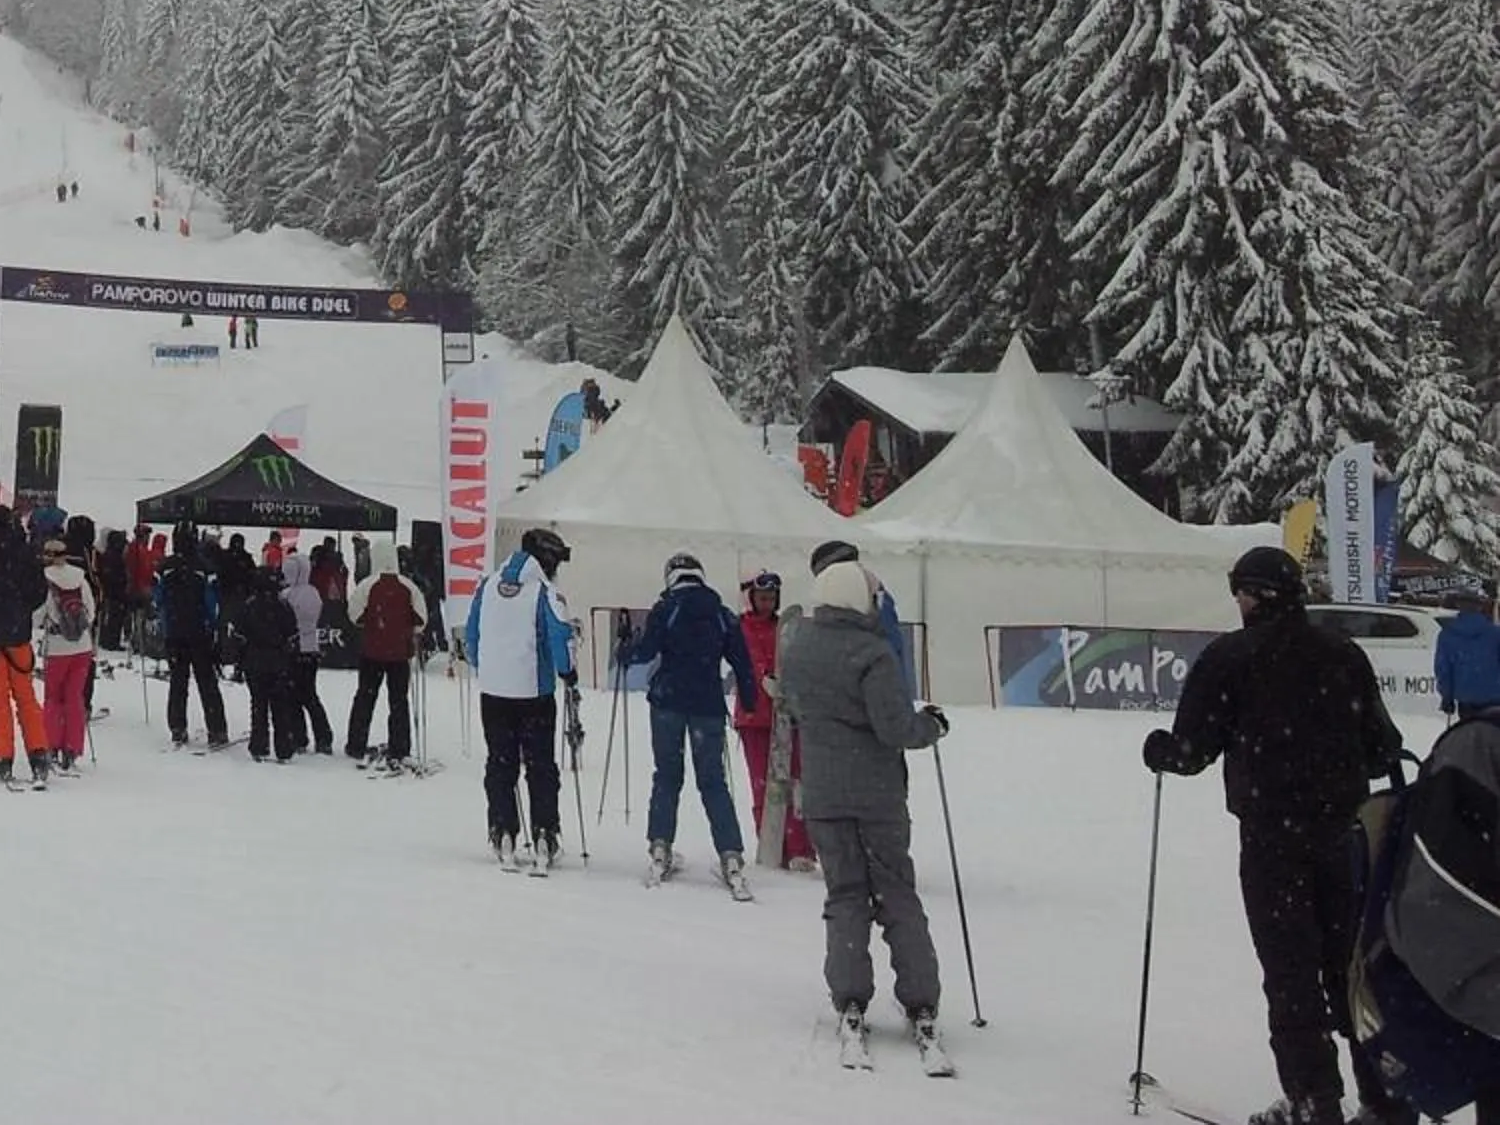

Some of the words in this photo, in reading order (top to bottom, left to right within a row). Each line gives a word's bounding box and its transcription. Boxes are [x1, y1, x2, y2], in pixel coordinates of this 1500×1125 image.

[91, 283, 202, 306] PAMPOROVO
[206, 291, 267, 310] WINTER
[271, 295, 307, 312] BIKE
[311, 297, 351, 313] DUEL
[448, 396, 489, 596] LACALUT
[1343, 458, 1359, 522] MOTORS
